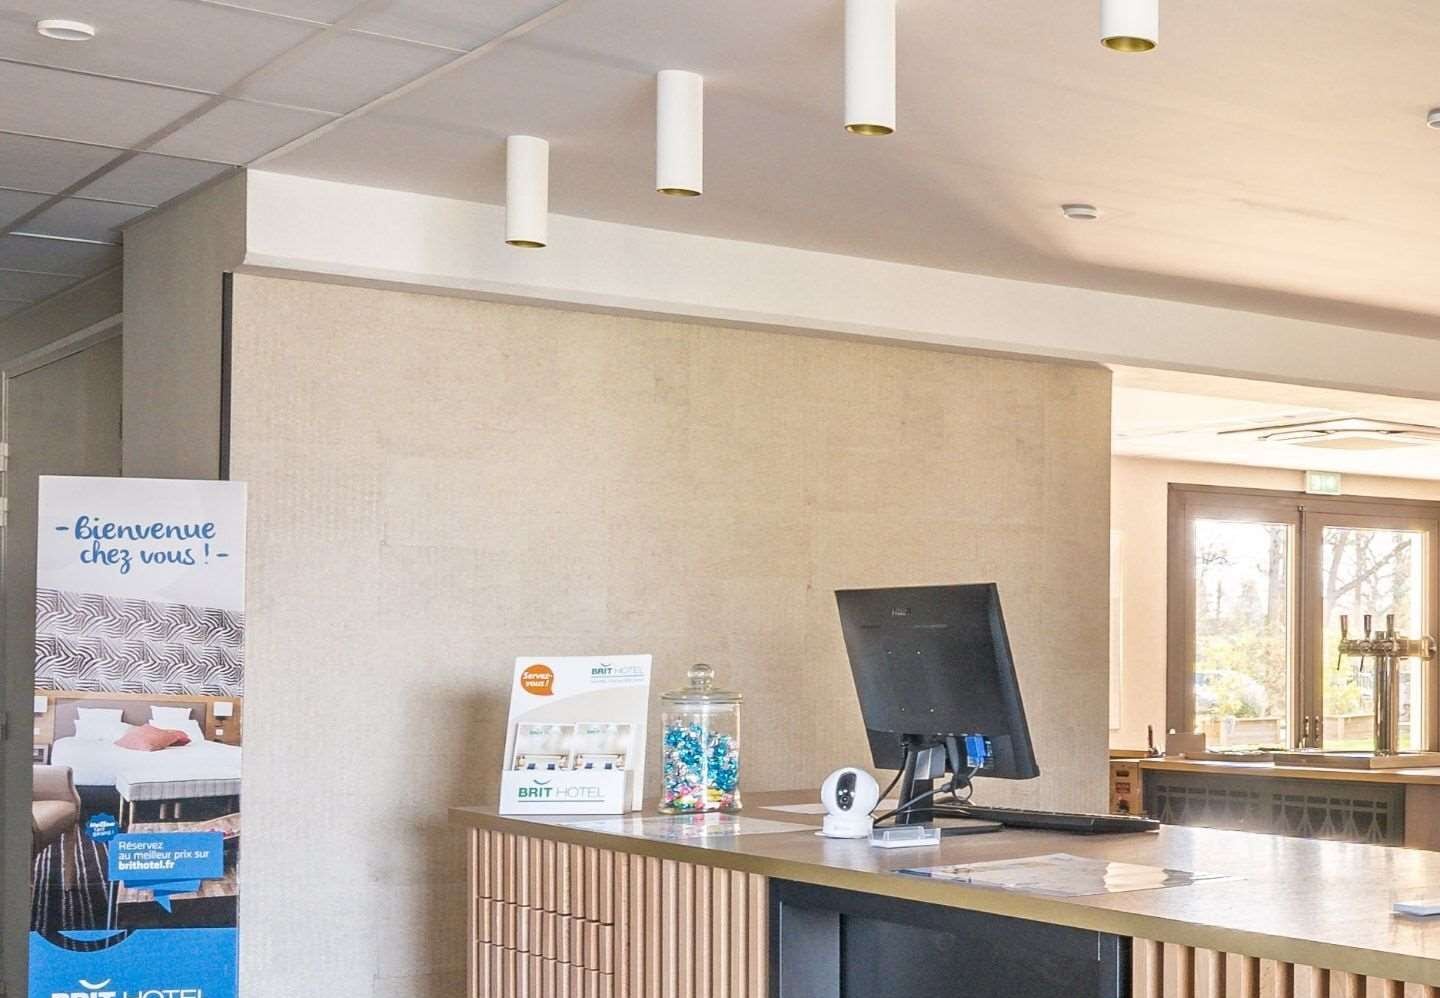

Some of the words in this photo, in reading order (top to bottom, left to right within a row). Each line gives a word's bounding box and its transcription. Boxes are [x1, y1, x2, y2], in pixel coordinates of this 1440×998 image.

[80, 540, 132, 575] chez
[140, 548, 195, 565] vous
[591, 667, 613, 675] BRIT
[518, 787, 552, 798] BRIT
[556, 786, 605, 798] HOTEL
[119, 840, 163, 850] Réservez
[119, 852, 130, 860] au
[133, 850, 171, 860] meilleur
[174, 850, 192, 861] prix
[194, 850, 210, 859] sur
[118, 860, 175, 871] brithotel.fr
